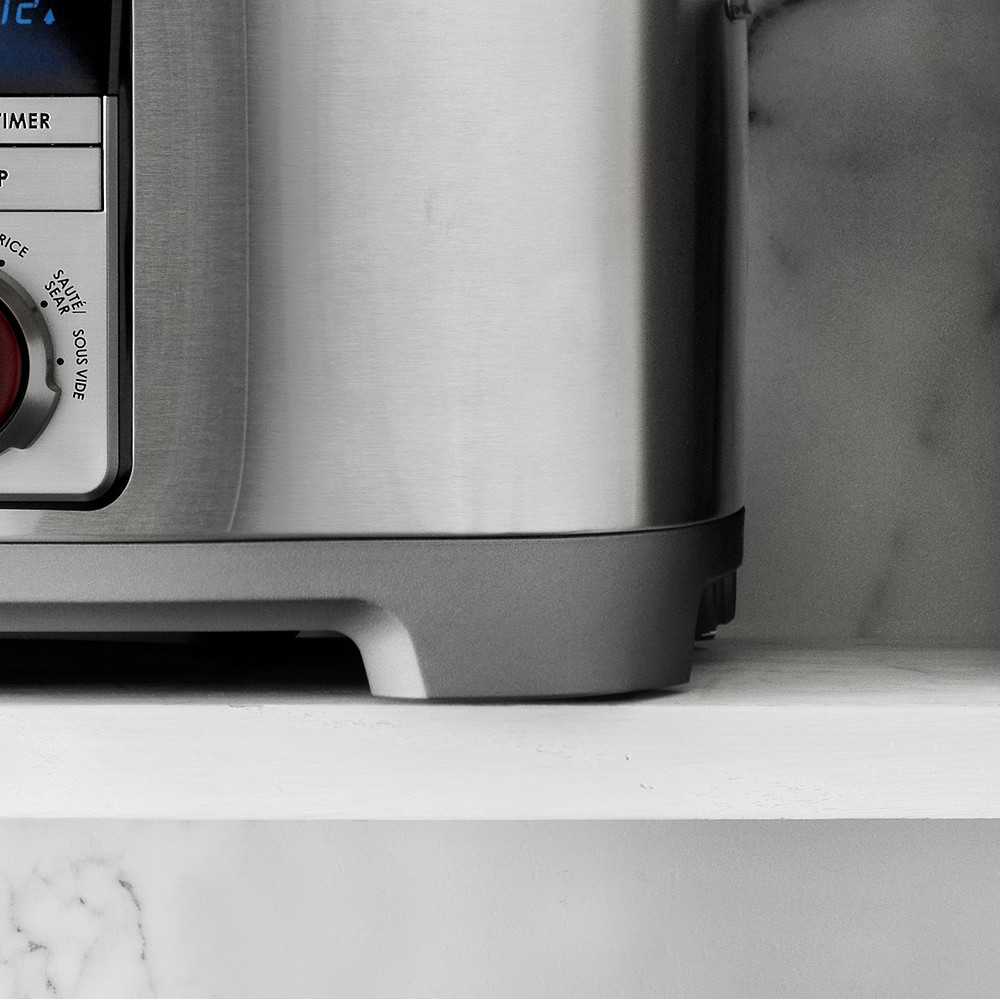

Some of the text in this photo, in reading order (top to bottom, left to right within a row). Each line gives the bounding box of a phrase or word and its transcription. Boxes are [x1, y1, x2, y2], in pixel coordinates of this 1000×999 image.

[45, 281, 70, 316] SEAR
[73, 328, 88, 400] SOUS VIDE
